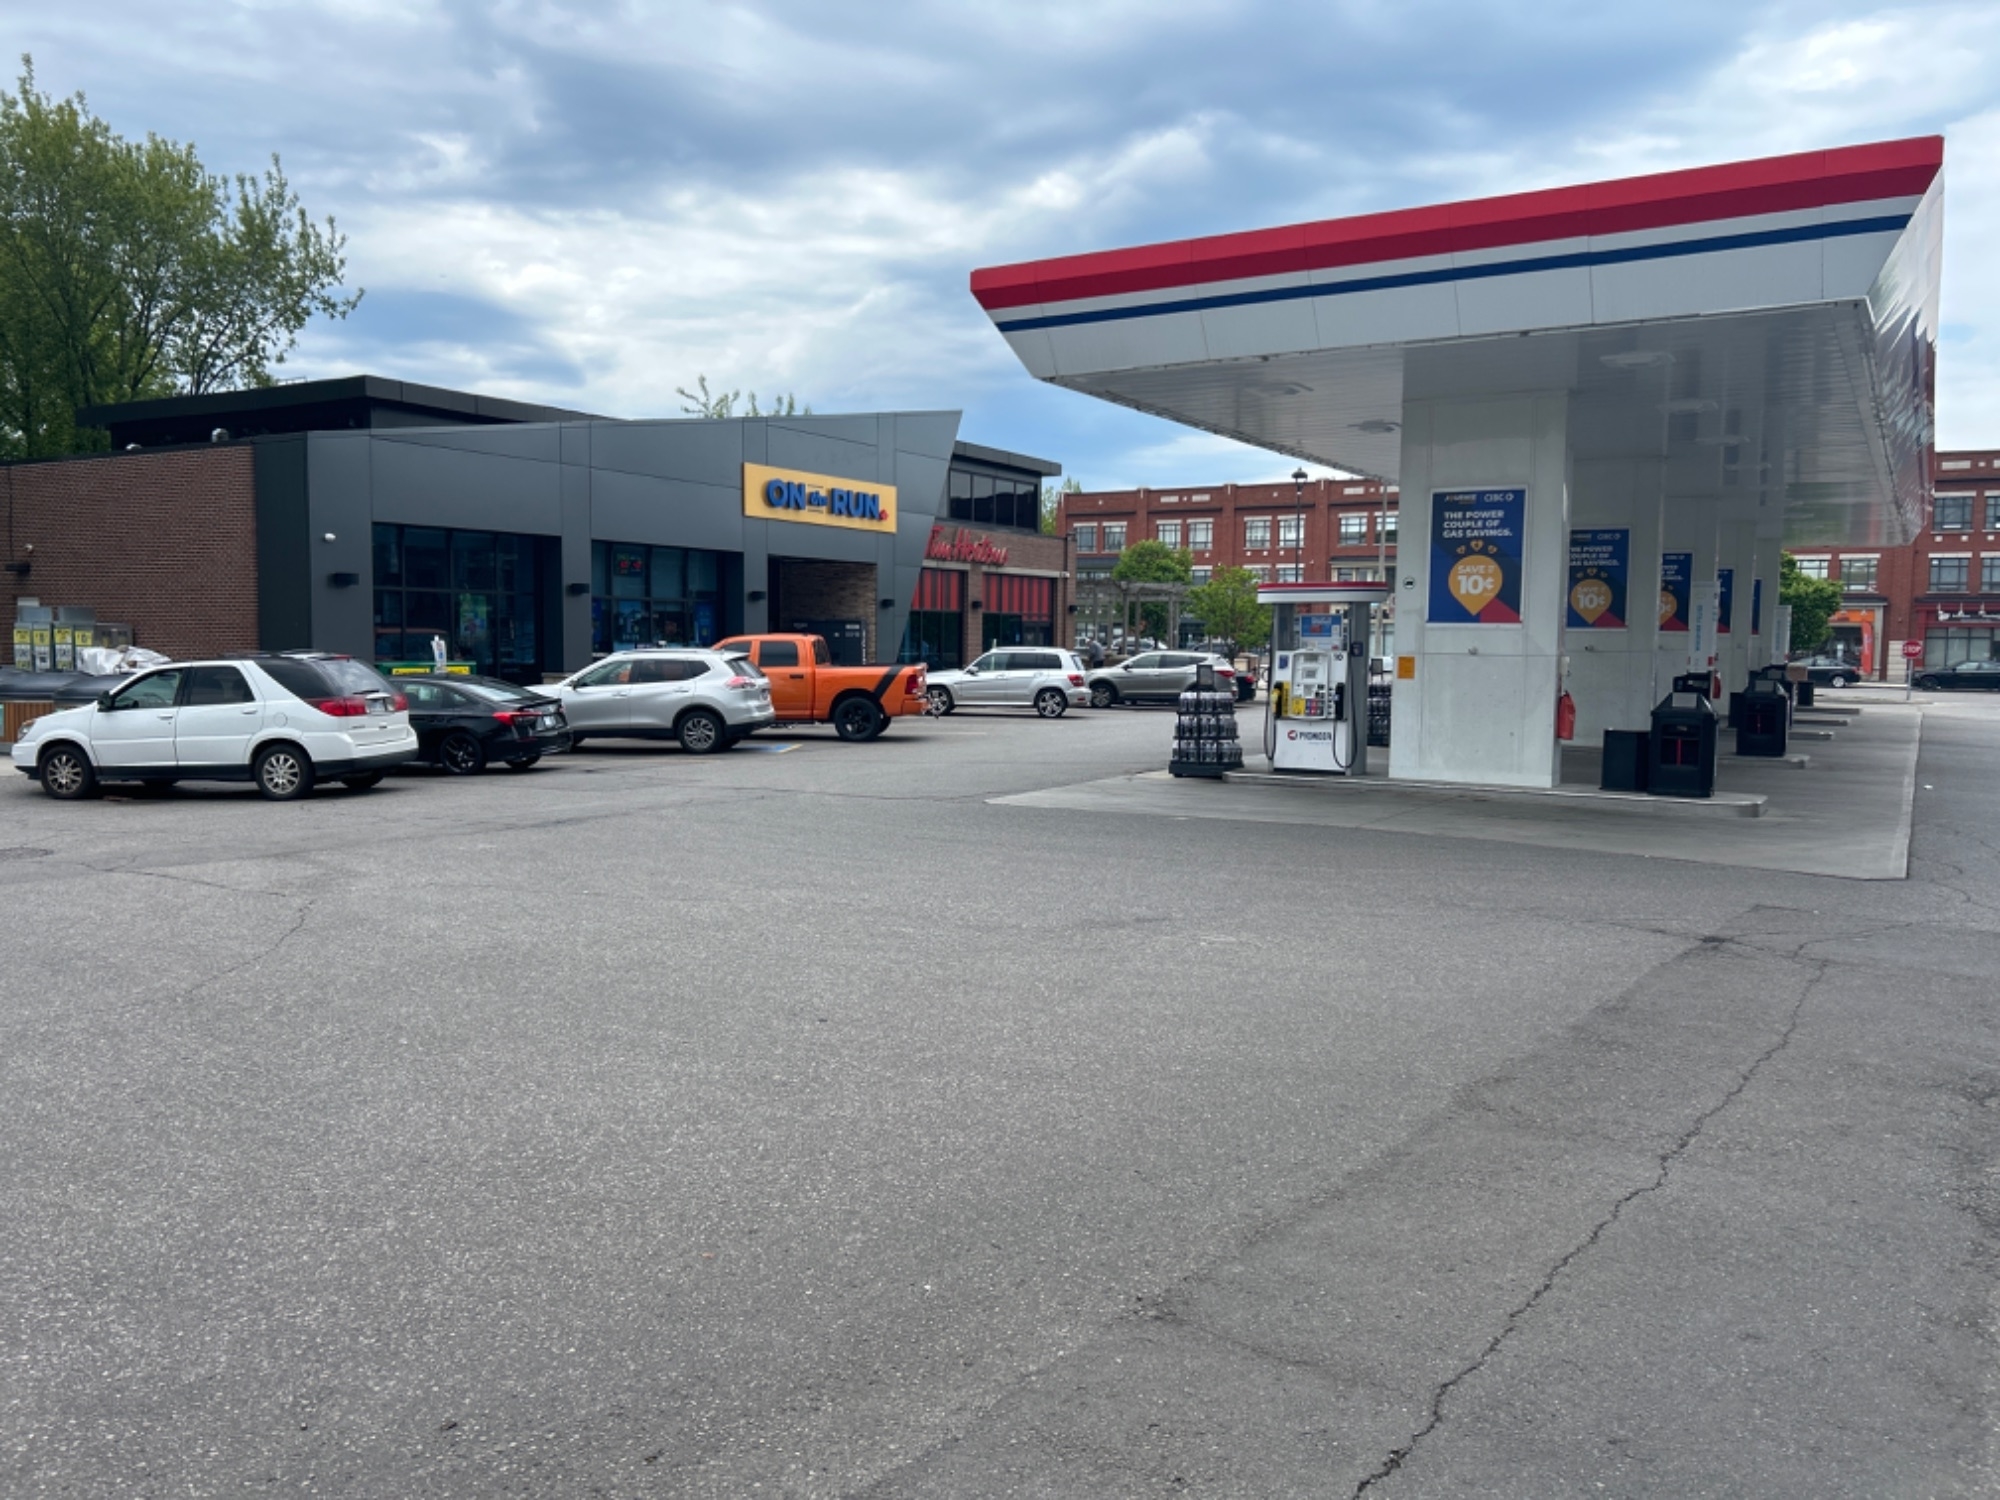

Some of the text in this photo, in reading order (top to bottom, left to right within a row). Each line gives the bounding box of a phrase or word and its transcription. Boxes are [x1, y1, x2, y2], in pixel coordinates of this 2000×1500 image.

[767, 479, 806, 510] ON
[809, 490, 827, 507] the
[1443, 510, 1504, 519] THE POWER
[1443, 519, 1501, 529] COUPLE OF
[1442, 528, 1513, 538] GAS SAVINGS.
[925, 524, 1008, 565] Tim Hortons
[1458, 565, 1486, 574] SAVE
[1904, 645, 1921, 653] STOP
